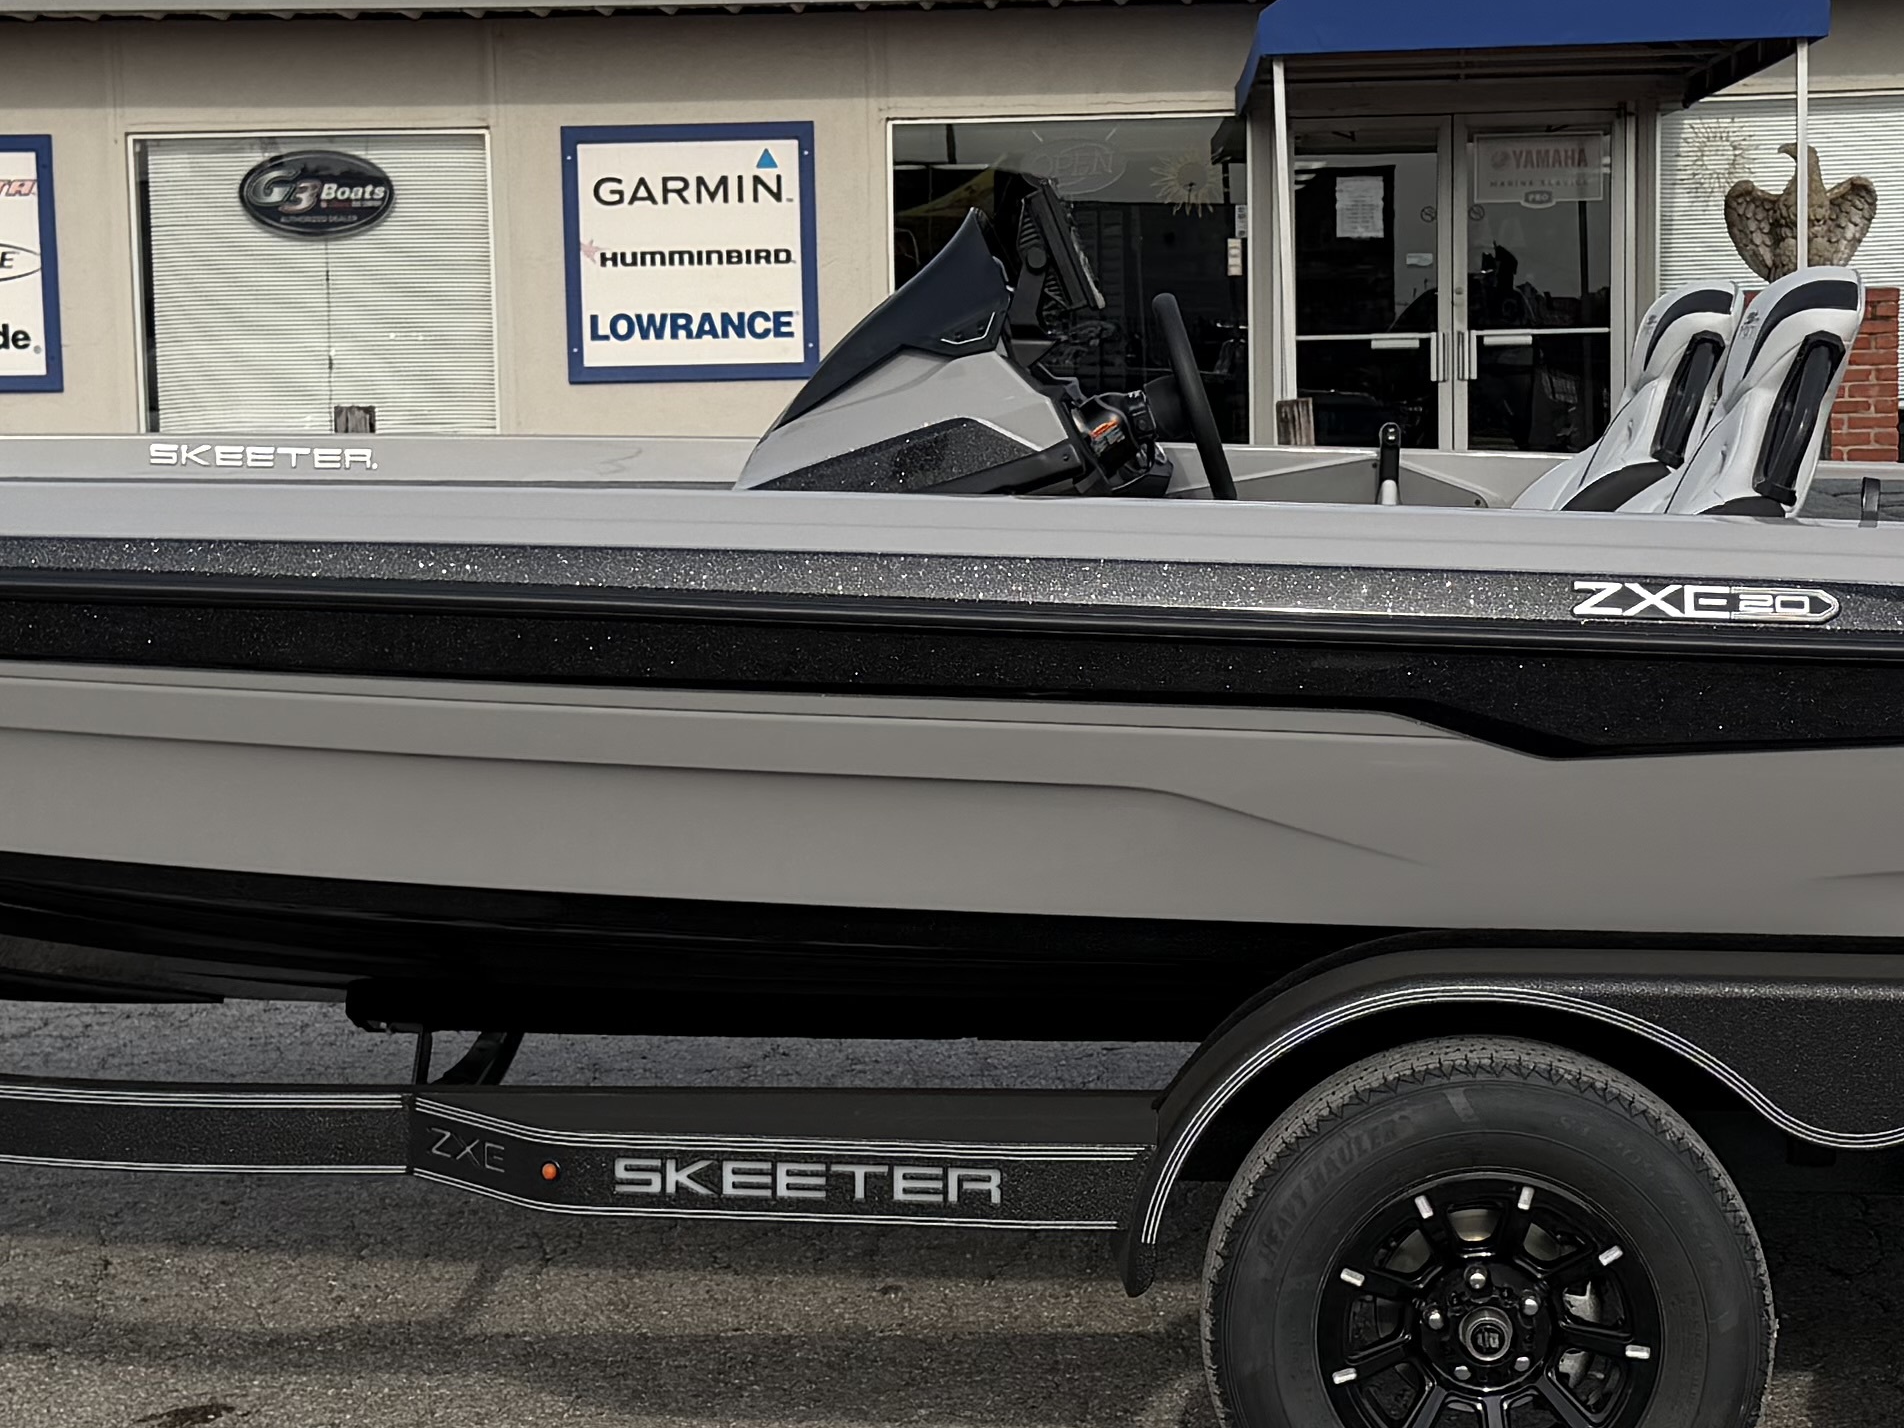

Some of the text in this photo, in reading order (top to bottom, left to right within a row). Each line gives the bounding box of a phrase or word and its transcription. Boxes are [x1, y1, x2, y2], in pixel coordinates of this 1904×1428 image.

[1512, 147, 1589, 169] YAMAHA
[247, 169, 386, 215] G3 Boats
[593, 173, 784, 207] GARMIN
[599, 248, 793, 268] HUMMINBIRD
[589, 310, 795, 341] LOWRANCE
[148, 443, 373, 470] SKEETER
[429, 1127, 506, 1172] ZXE
[613, 1156, 1004, 1207] SKEETER
